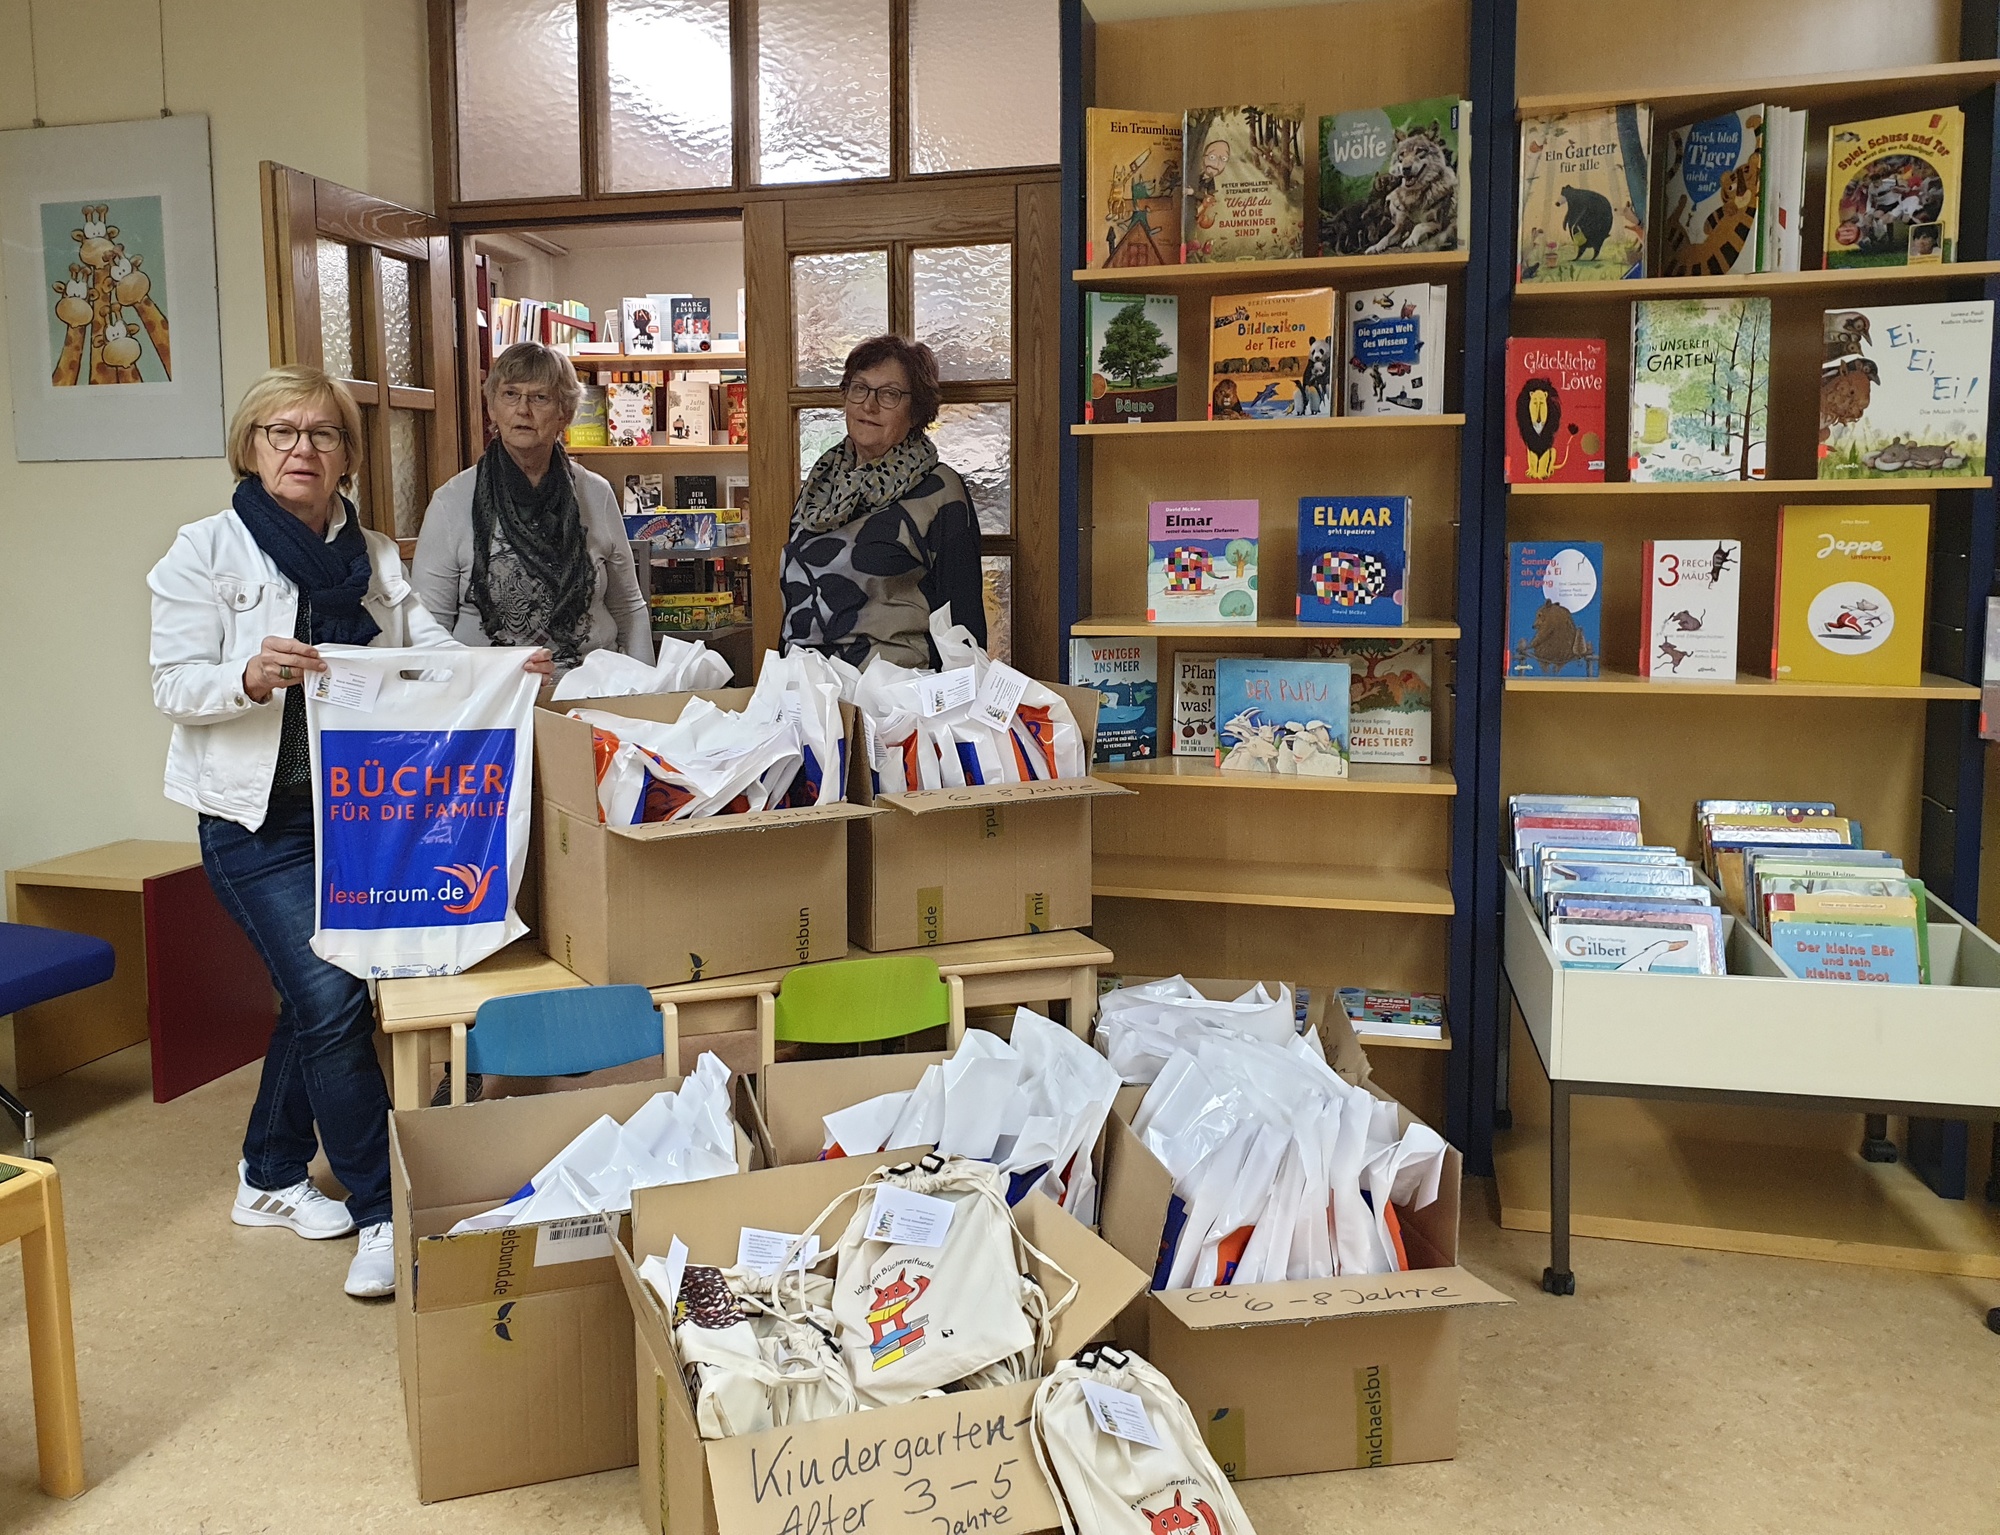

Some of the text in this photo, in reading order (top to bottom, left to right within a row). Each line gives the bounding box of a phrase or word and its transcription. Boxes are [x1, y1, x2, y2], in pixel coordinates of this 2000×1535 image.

[1111, 121, 1183, 136] Ein Traumhau
[1717, 131, 1739, 143] bloß
[1868, 133, 1909, 149] Schuss
[1912, 134, 1934, 146] und
[1932, 139, 1950, 157] Tor
[1334, 135, 1387, 163] Wölfe
[1545, 142, 1617, 161] Ein Garten
[1688, 144, 1736, 170] Tiger
[1560, 159, 1600, 173] für alle
[1686, 171, 1708, 181] nicht
[1224, 196, 1272, 209] Weißt du
[1232, 209, 1247, 217] WO
[1219, 218, 1276, 228] BAUMKINDER
[1235, 229, 1260, 237] SIND?
[1238, 319, 1306, 336] Bildlexikon
[1358, 323, 1413, 338] Die ganze Welt
[1245, 337, 1297, 351] der Tiere
[1363, 337, 1408, 348] des Wissens
[1887, 324, 1920, 348] Ei,
[1660, 339, 1710, 352] UNSEREM
[1524, 350, 1596, 374] Glückliche
[1647, 352, 1713, 372] GARTEN
[1907, 349, 1935, 375] Ei,
[1561, 371, 1602, 390] Löwe
[1115, 398, 1154, 413] Bäume
[1166, 515, 1213, 527] Elmar
[1314, 506, 1392, 526] ELMAR
[1817, 533, 1883, 559] Jeppe
[1851, 554, 1891, 562] unterwegs
[1521, 568, 1533, 576] als
[1535, 568, 1551, 576] das
[1658, 554, 1680, 586] 3
[1092, 647, 1140, 661] WENIGER
[1094, 660, 1140, 673] INS MEER
[1245, 680, 1329, 702] DER PUPU
[1181, 698, 1211, 713] was!
[1363, 727, 1413, 737] MAL HIER!
[1351, 737, 1414, 747] CHES TIER?
[330, 759, 505, 797] BÜCHER
[1017, 784, 1099, 796] Jahre
[330, 800, 506, 821] FÜR DIE FAMILIE
[329, 880, 464, 905] lesetraum.de
[1806, 930, 1854, 938] BUNTING
[1565, 936, 1627, 956] Gilbert
[1797, 941, 1895, 957] Der kleine Bär
[1822, 956, 1871, 967] und sein
[1806, 966, 1890, 982] kleines Boot
[493, 1229, 517, 1296] elsbund.de
[871, 1273, 882, 1285] ein
[881, 1257, 935, 1276] Büchereifuchs
[1342, 1285, 1463, 1305] Jahre
[1363, 1365, 1383, 1468] michaelsbu
[904, 1459, 1019, 1514] 3 5
[777, 1494, 1013, 1535] Alter Jahre
